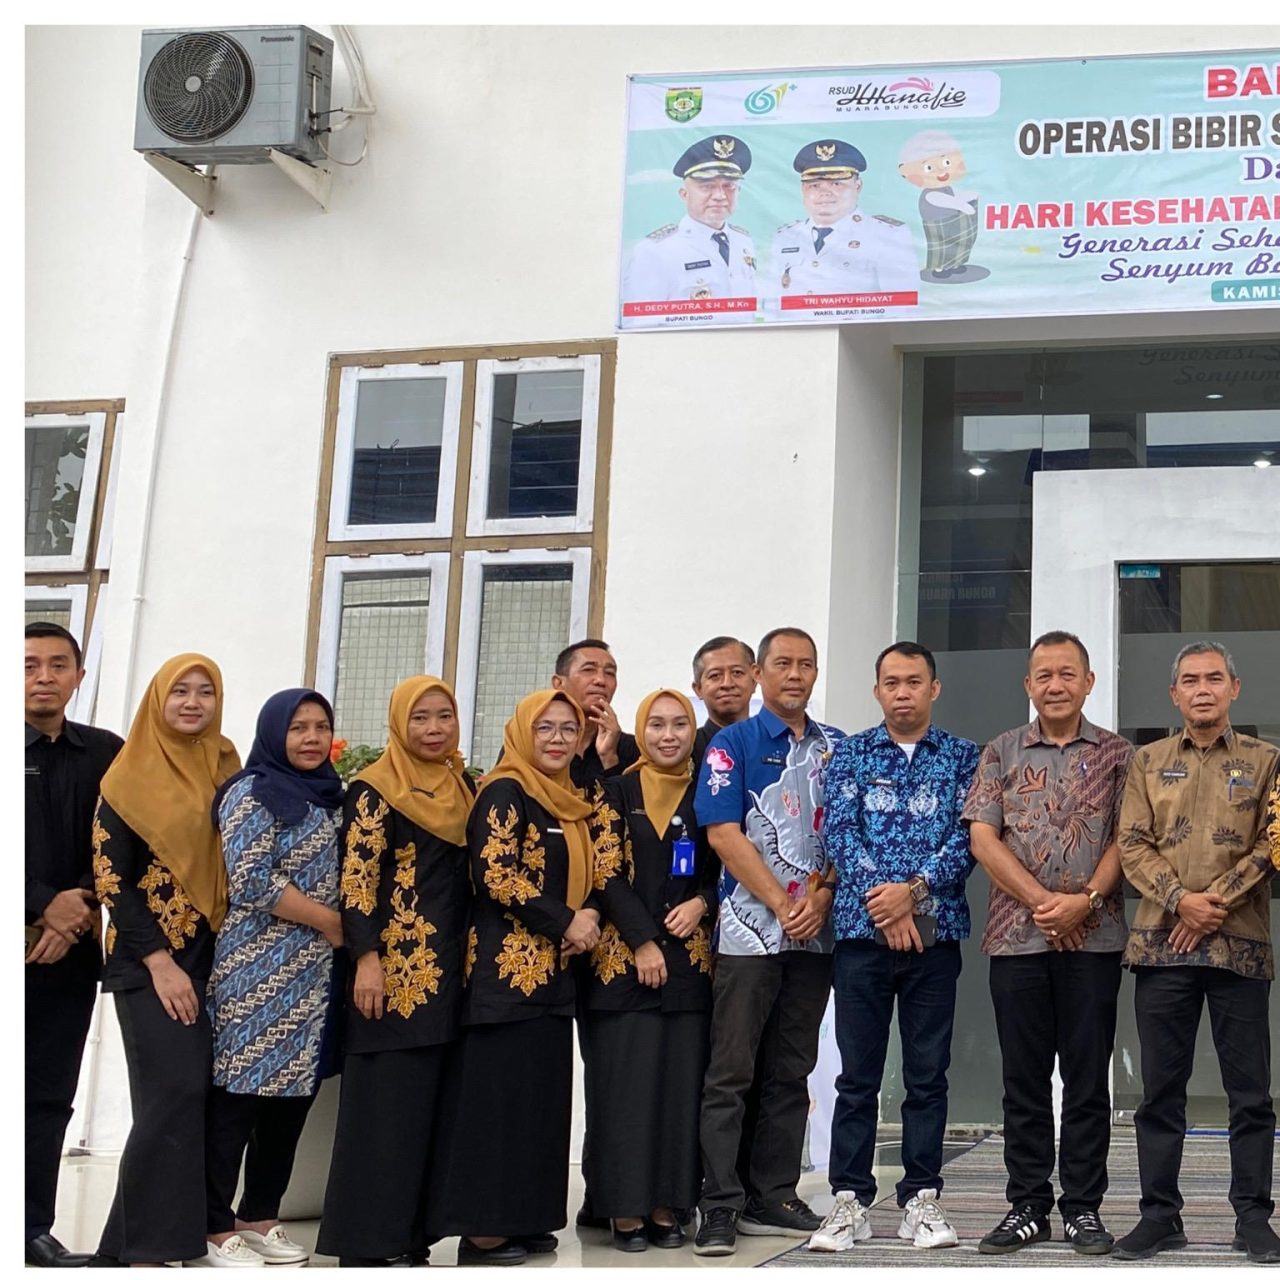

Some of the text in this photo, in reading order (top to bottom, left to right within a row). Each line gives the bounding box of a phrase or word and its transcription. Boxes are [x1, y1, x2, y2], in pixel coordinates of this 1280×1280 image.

[828, 86, 855, 96] RSUD
[1019, 118, 1161, 155] OPERASI
[1172, 114, 1261, 150] BIBIR
[986, 203, 1073, 230] HARI
[1058, 229, 1203, 259] Generasi
[1100, 257, 1233, 284] Senyum
[645, 304, 669, 312] DEDY
[727, 301, 749, 309] M.Kn
[856, 295, 893, 303] HIDAYAT
